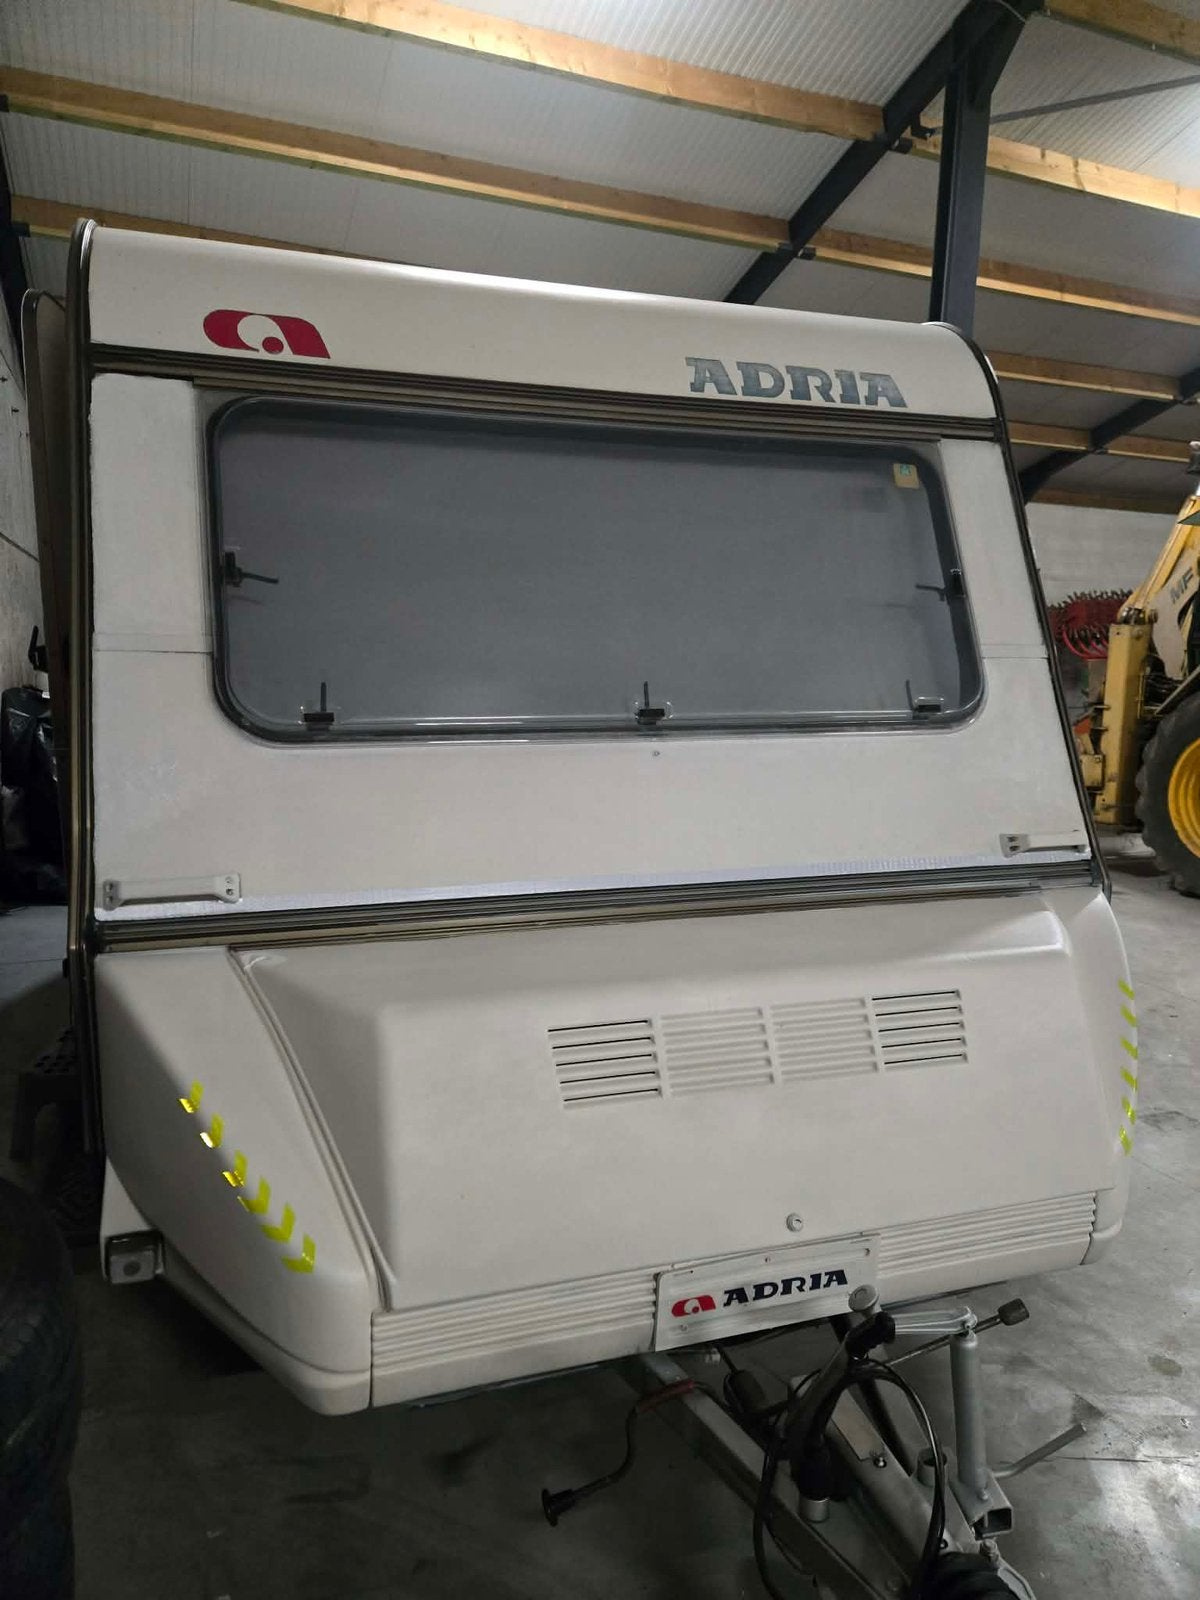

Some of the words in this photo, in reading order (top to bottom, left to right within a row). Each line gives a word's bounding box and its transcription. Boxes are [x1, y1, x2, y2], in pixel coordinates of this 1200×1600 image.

[685, 356, 907, 408] ADRIA
[1169, 566, 1194, 604] MF
[723, 1269, 848, 1307] ADRIA
